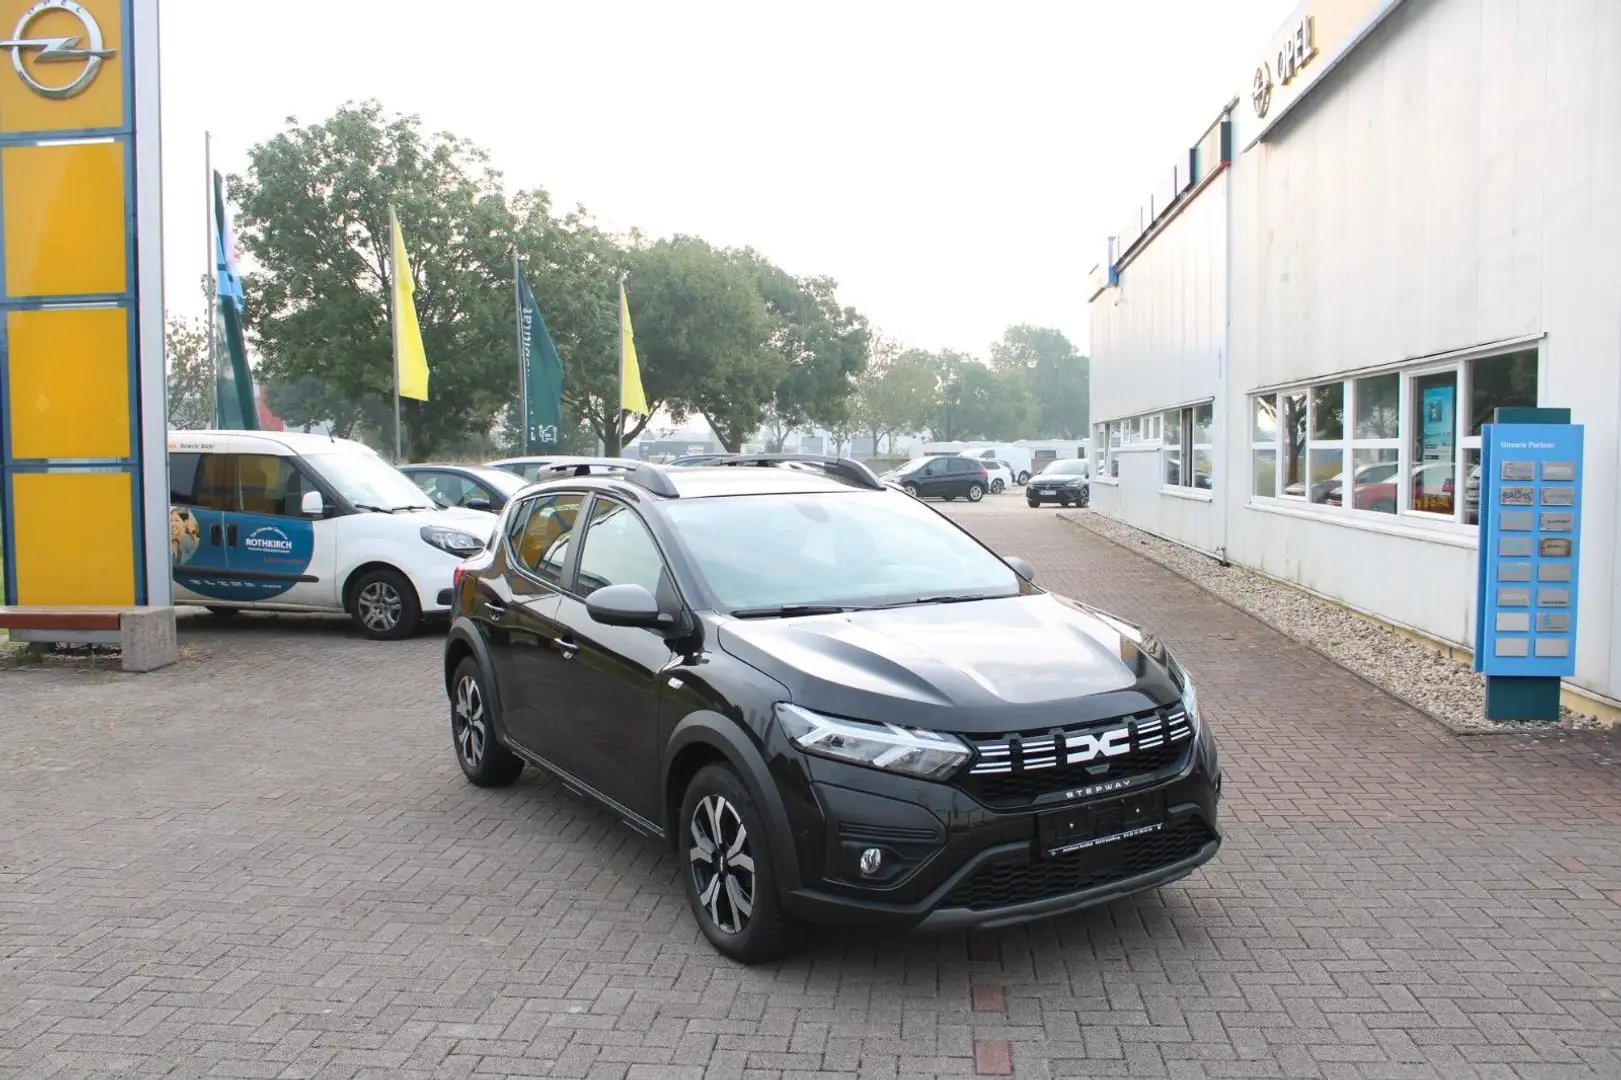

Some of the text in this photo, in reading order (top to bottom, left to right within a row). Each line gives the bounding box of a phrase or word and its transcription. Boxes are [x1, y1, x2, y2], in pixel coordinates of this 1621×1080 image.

[1276, 14, 1318, 85] OPEL
[246, 538, 292, 550] ROTHKIRCH
[1065, 780, 1131, 799] STEPWAY
